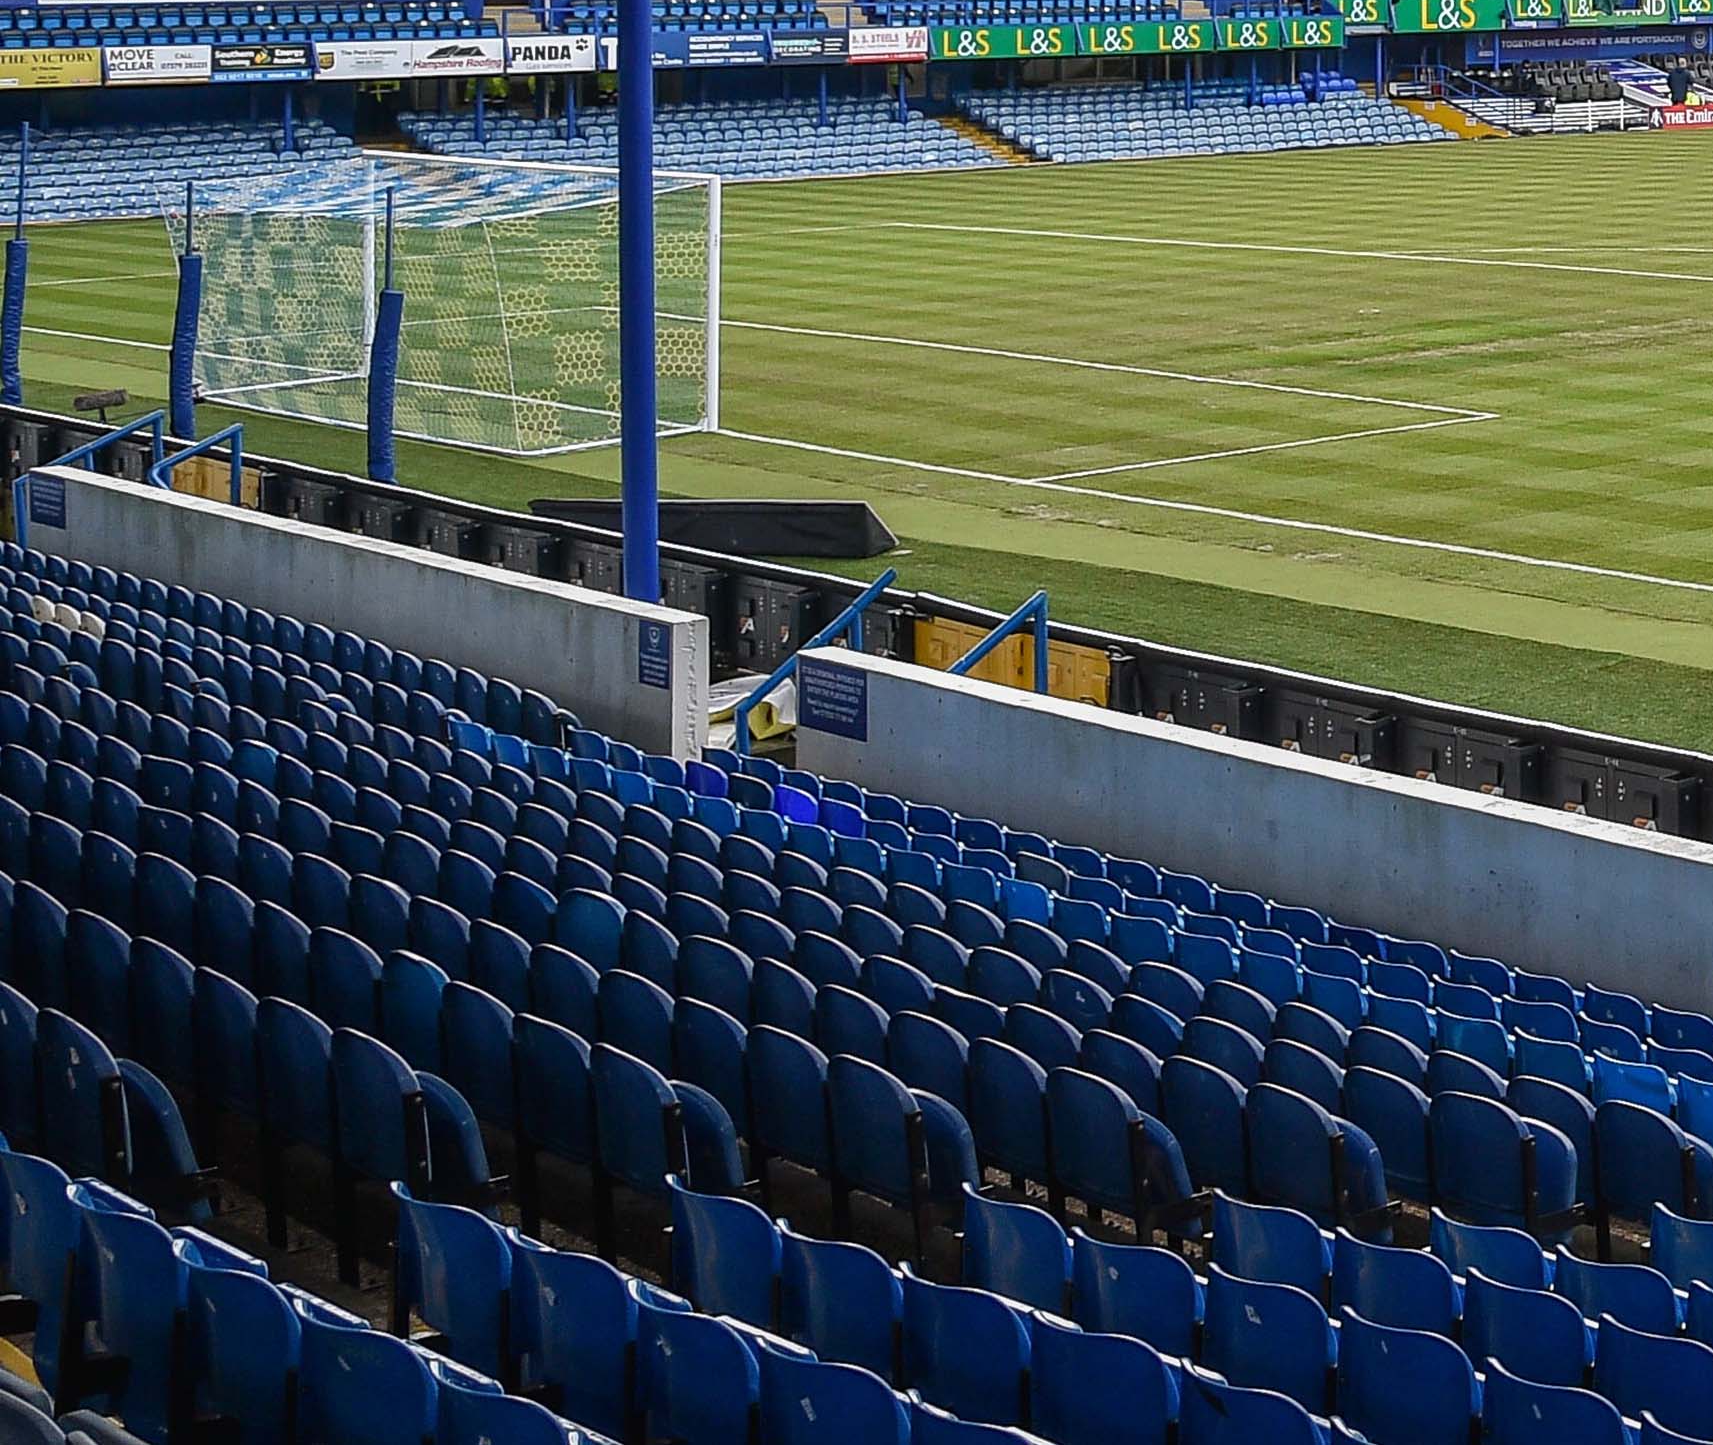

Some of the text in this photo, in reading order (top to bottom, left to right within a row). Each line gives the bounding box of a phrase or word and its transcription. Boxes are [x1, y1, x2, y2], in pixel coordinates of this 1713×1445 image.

[943, 29, 990, 56] L&S
[1017, 28, 1062, 54] L&S
[1090, 26, 1133, 53] L&S
[1159, 25, 1201, 51] L&S
[1227, 22, 1268, 48] L&S
[1292, 21, 1331, 46] L&S
[1501, 35, 1686, 50] TOGETHER WE ACHIEVE WE ARE PORTSMOUTH
[0, 52, 95, 65] THE VICTORY
[110, 49, 155, 60] MOVE
[511, 45, 572, 61] PANDA
[414, 57, 503, 70] Hampshire Roofing
[1664, 111, 1686, 124] THE
